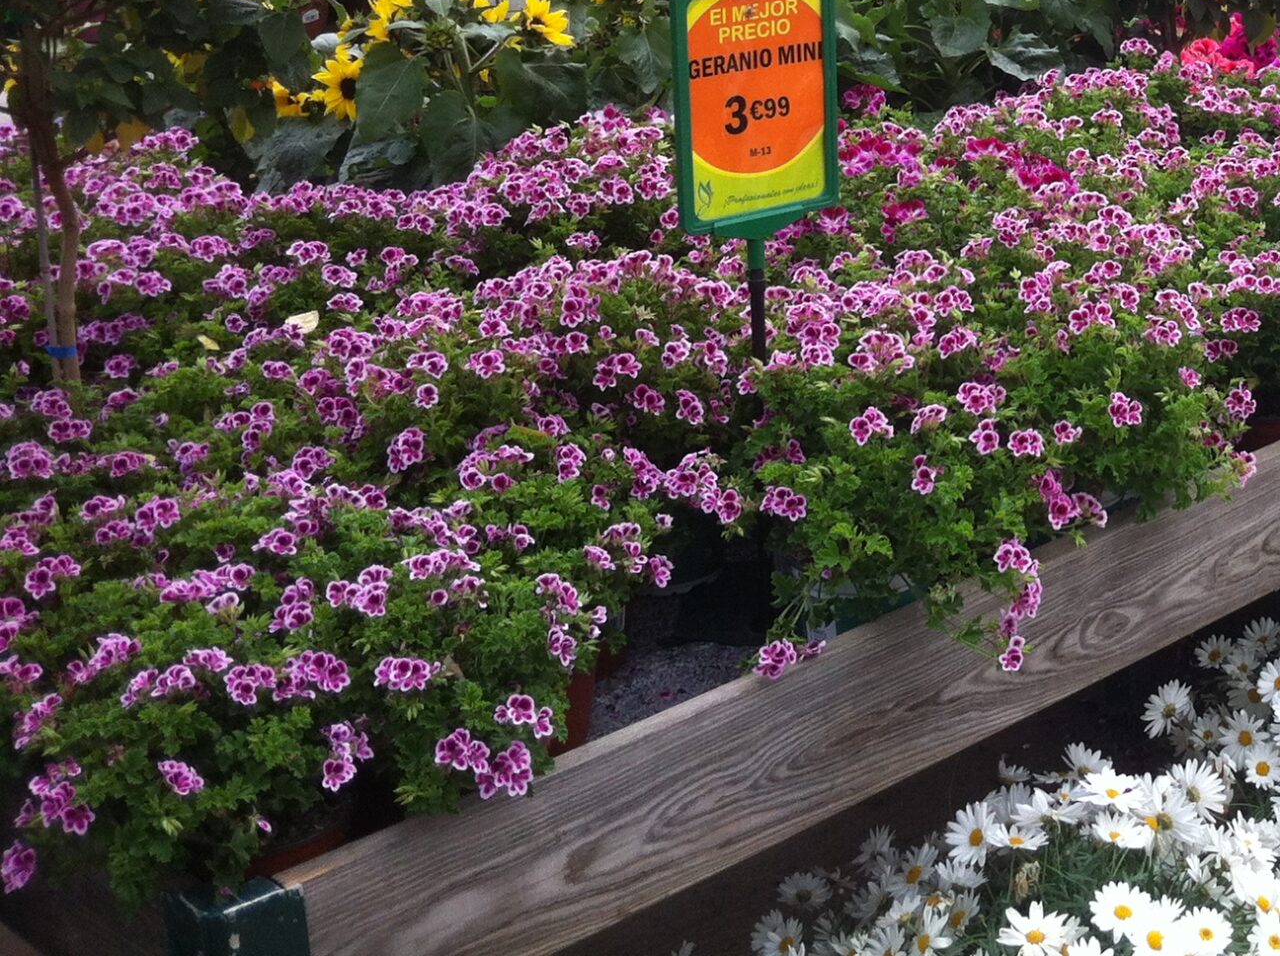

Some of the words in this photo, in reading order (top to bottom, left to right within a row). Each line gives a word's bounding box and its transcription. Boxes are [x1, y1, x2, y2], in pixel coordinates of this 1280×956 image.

[718, 18, 791, 44] PRECIO
[689, 47, 773, 80] GERANIO
[778, 41, 824, 65] MINI
[724, 95, 791, 135] 3€99
